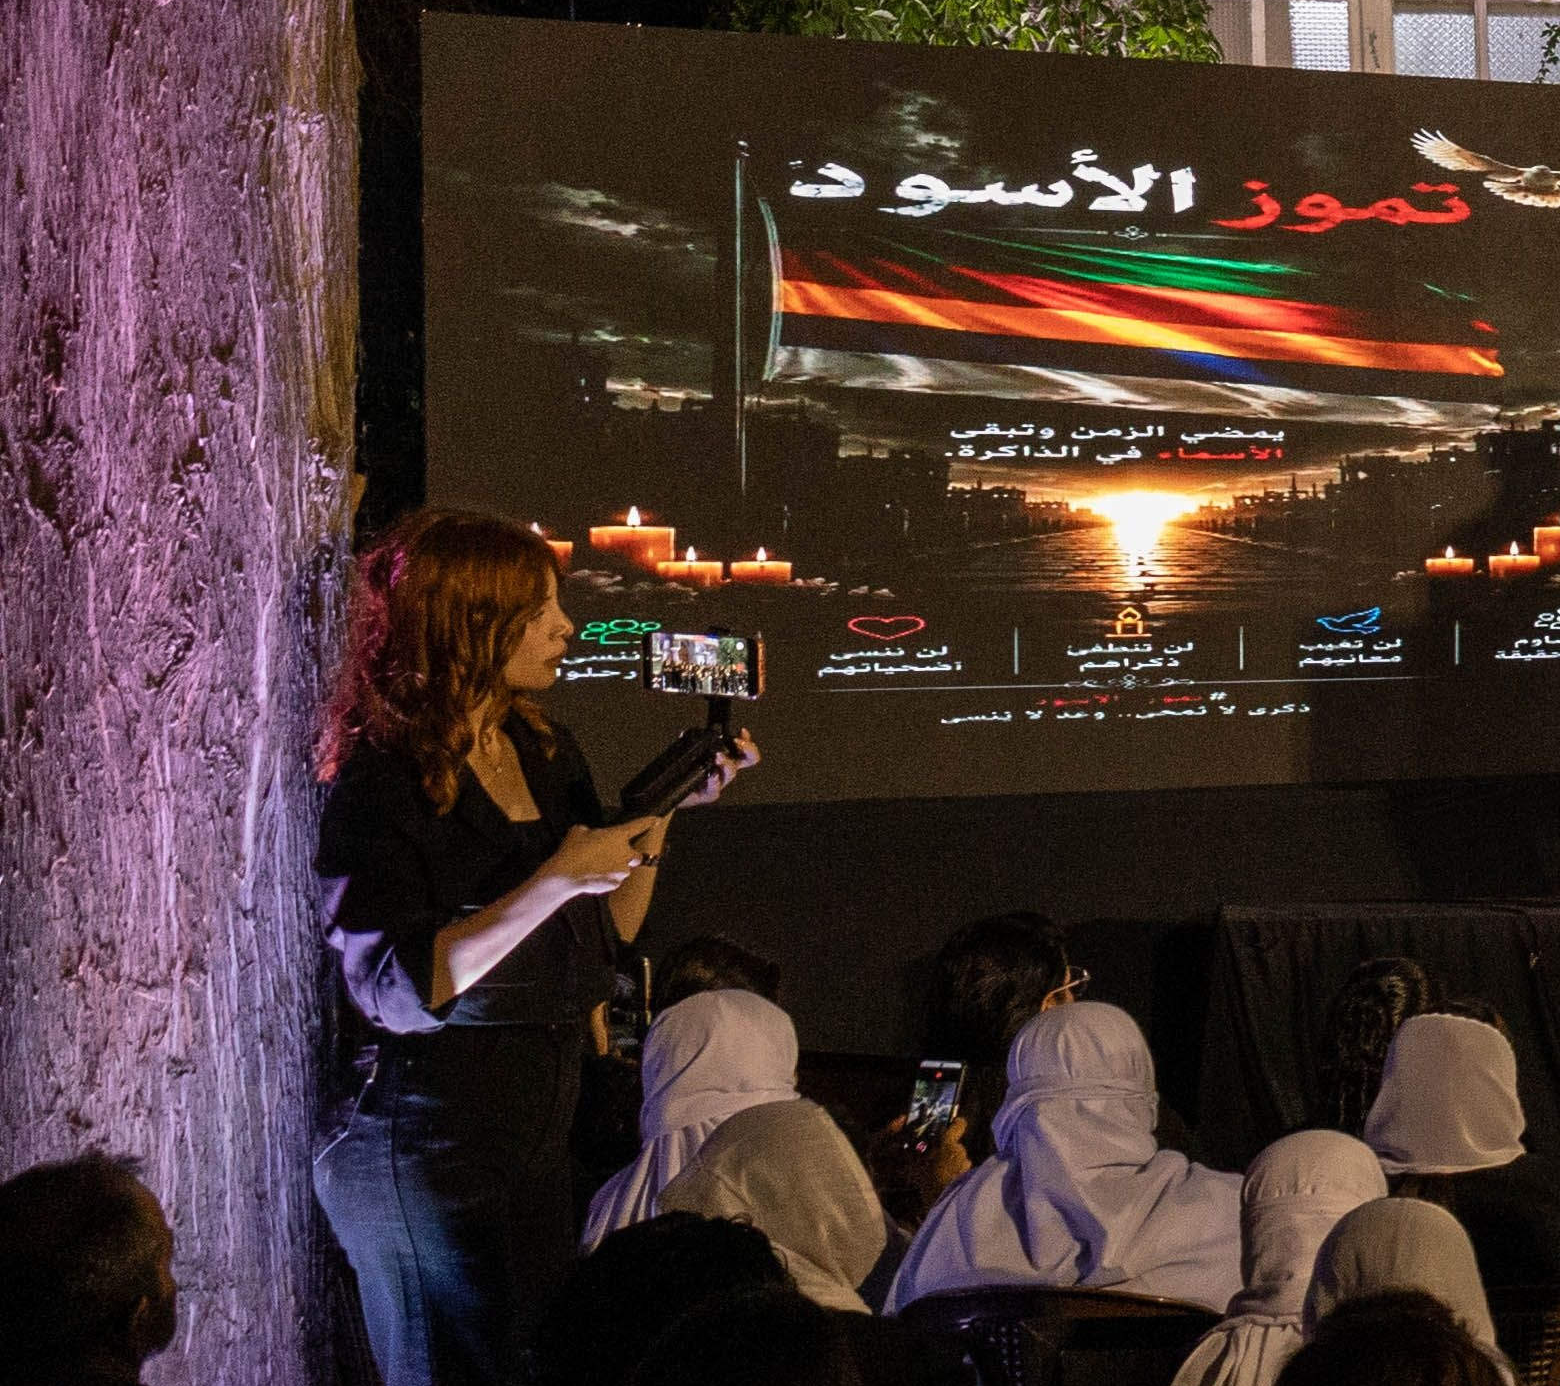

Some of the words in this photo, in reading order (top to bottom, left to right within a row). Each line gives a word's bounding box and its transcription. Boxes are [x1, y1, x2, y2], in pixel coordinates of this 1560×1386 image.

[790, 149, 1196, 216] الأسود
[1211, 178, 1471, 233] تموز
[949, 423, 1055, 439] وتبقى
[1070, 425, 1165, 440] الزمن
[1181, 426, 1285, 444] يمضي
[1095, 446, 1143, 465] في
[1157, 446, 1284, 460] الأسماء
[916, 645, 948, 659] لن
[1163, 642, 1194, 654] لن
[1372, 638, 1402, 651] لن
[1079, 657, 1180, 672] ذكراهم
[1024, 710, 1044, 720] لا
[1218, 705, 1237, 715] لا
